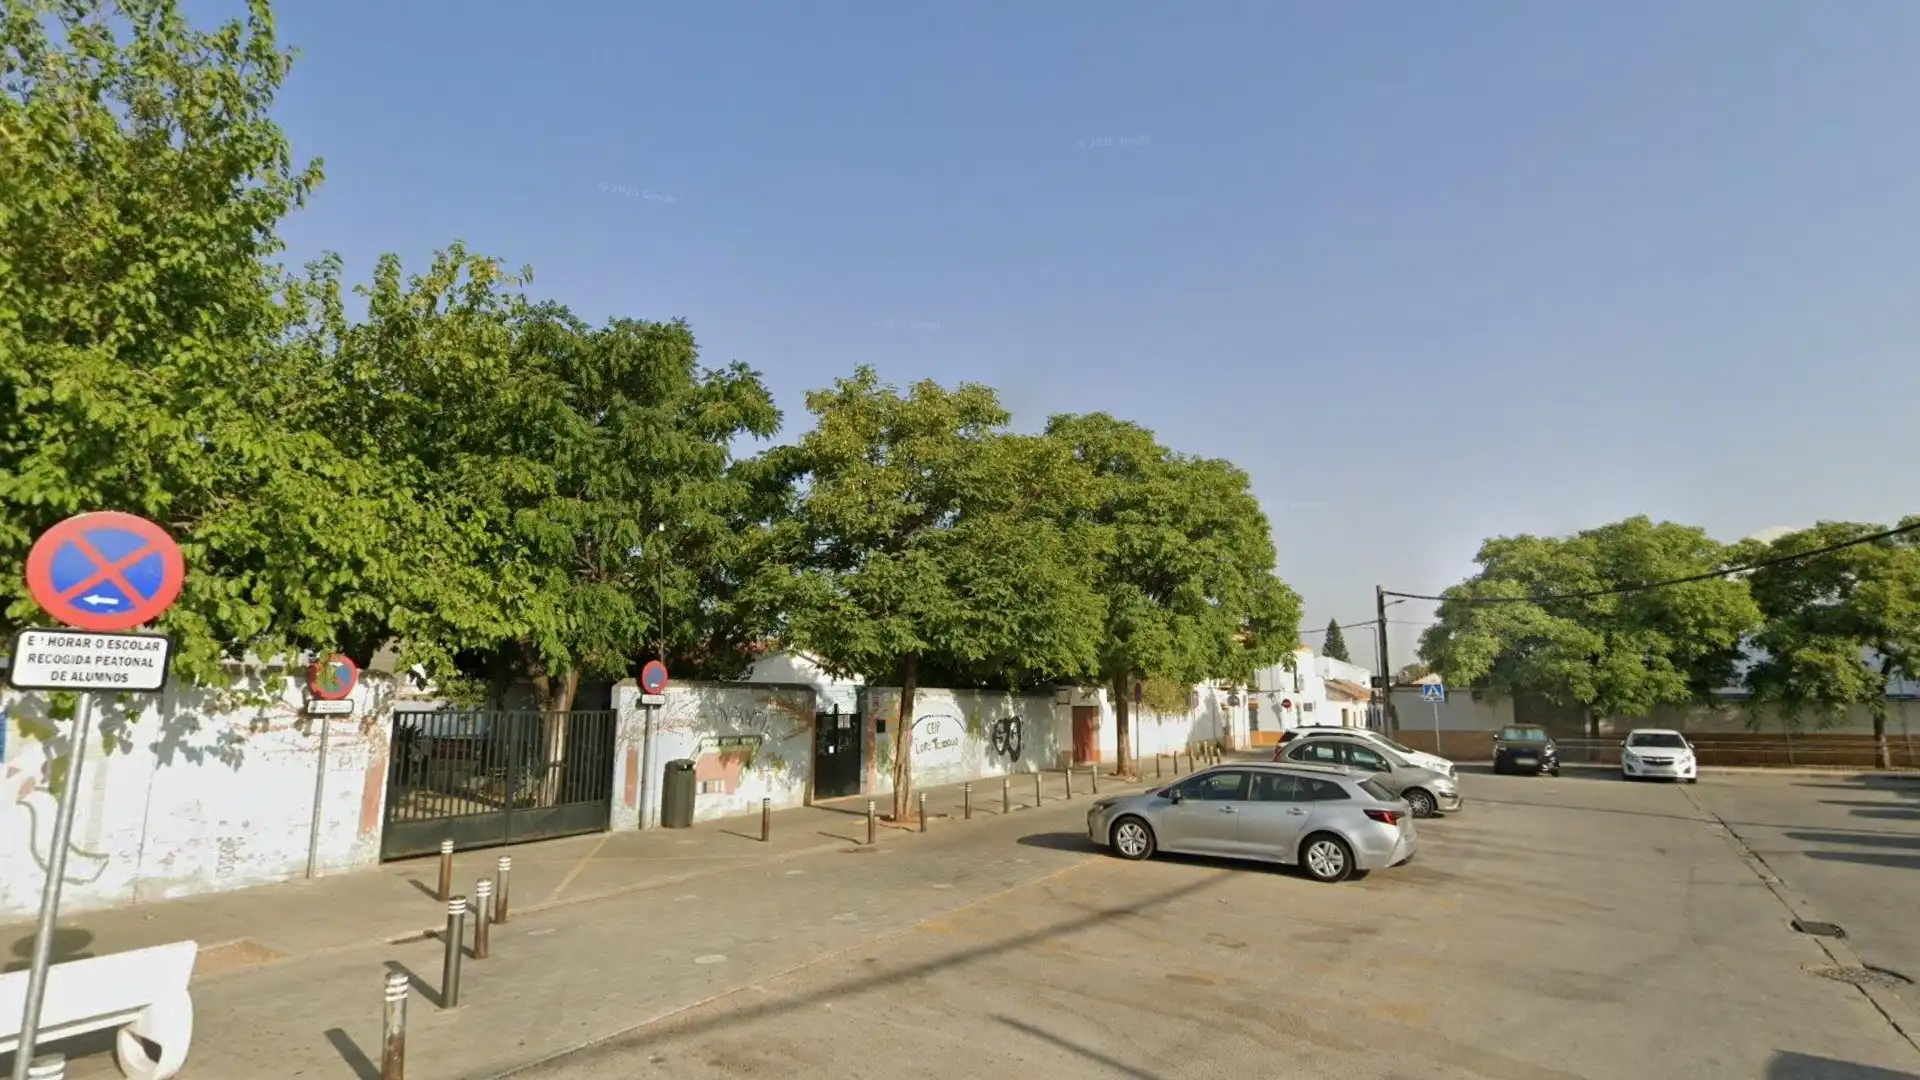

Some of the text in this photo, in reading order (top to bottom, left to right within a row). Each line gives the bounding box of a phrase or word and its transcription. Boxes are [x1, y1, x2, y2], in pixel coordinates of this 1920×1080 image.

[47, 636, 104, 649] HORARO
[107, 639, 160, 651] ESCOLAR
[27, 653, 154, 668] RECOGIDA PEATONAL
[51, 670, 129, 683] DE ALUMNOS
